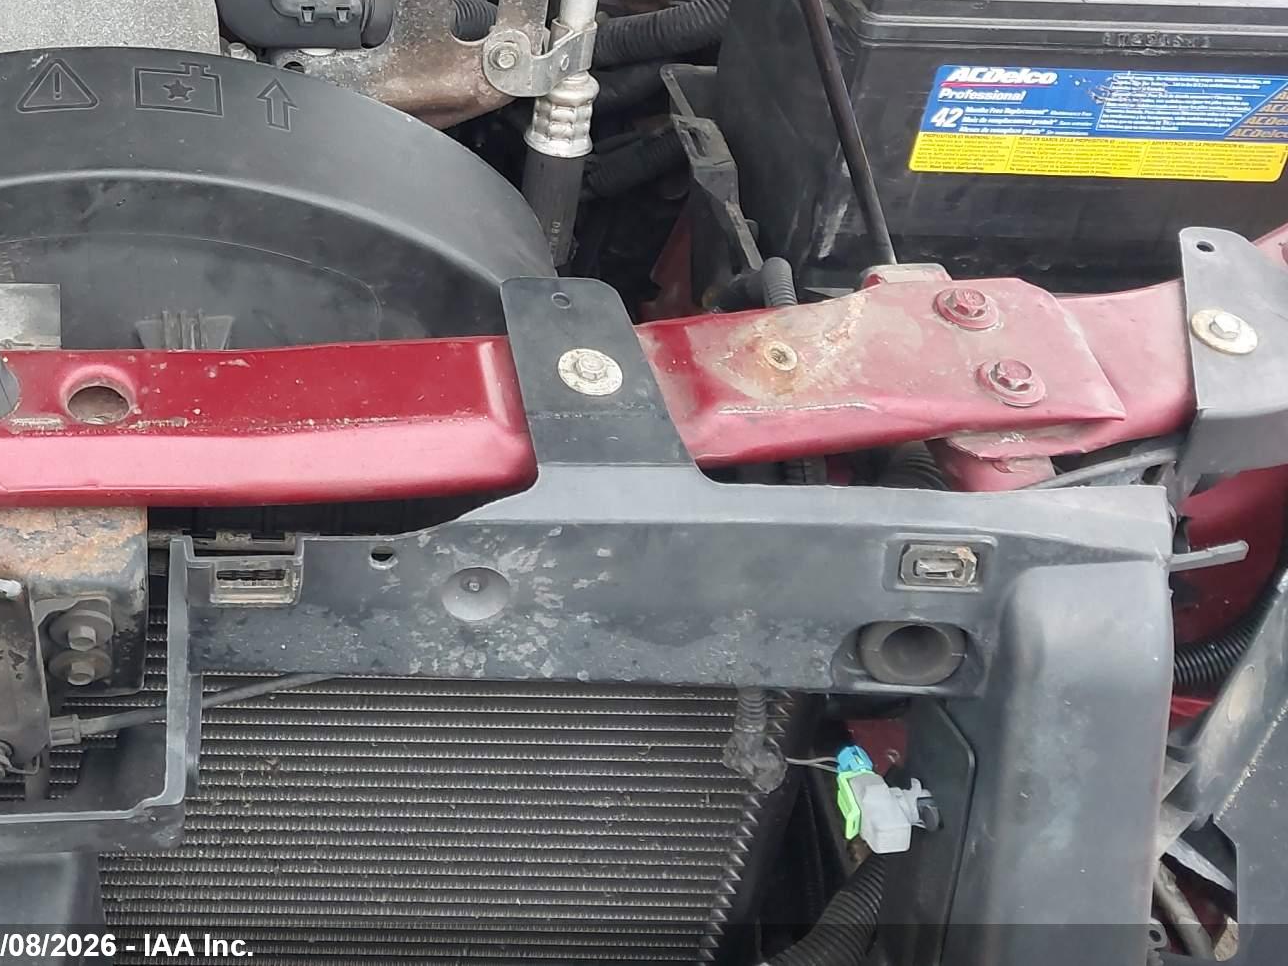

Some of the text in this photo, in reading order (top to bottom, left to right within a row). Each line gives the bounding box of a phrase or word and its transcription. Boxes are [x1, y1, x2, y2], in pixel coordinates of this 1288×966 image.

[945, 67, 1058, 84] ACDelco
[939, 88, 1027, 102] Professional
[931, 107, 964, 128] 42
